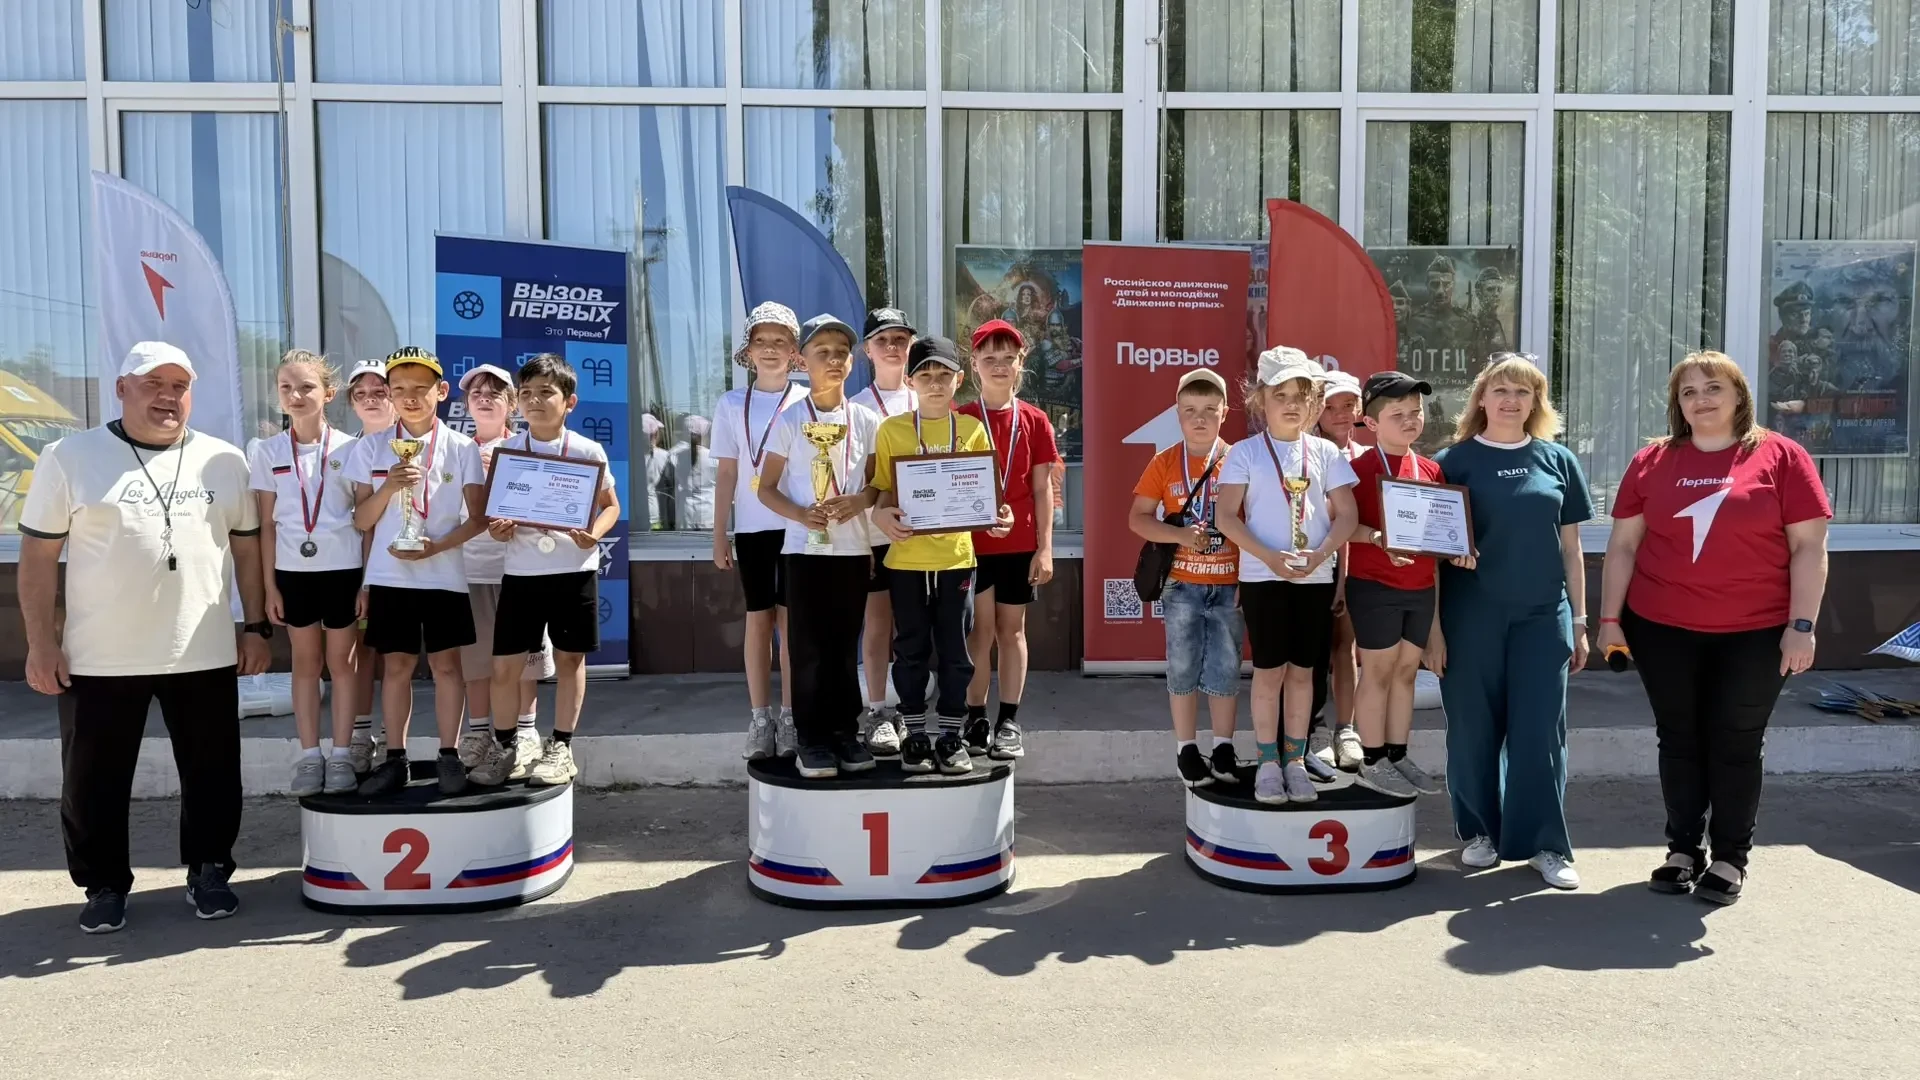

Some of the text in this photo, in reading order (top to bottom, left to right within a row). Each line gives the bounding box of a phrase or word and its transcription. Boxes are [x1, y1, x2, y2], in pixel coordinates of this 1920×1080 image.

[1104, 277, 1229, 290] Российское движение
[513, 282, 603, 301] ВЫЗОВ
[1116, 289, 1149, 297] детей
[1160, 290, 1218, 299] молодёжи
[1112, 298, 1225, 310] «Движение первых»
[509, 301, 614, 323] ПЕРВЫХ
[544, 327, 563, 336] Это
[1117, 342, 1220, 373] Первые
[1412, 348, 1467, 374] ОТЕЦ
[951, 473, 979, 481] Грамота
[1497, 467, 1529, 477] ENJOY
[551, 475, 580, 484] Грамота
[1676, 476, 1734, 488] Первые
[117, 480, 215, 504] Los Angeles
[1186, 562, 1235, 574] REMEMBER
[862, 812, 889, 876] 1
[1307, 819, 1350, 876] 3
[383, 828, 431, 890] 2
